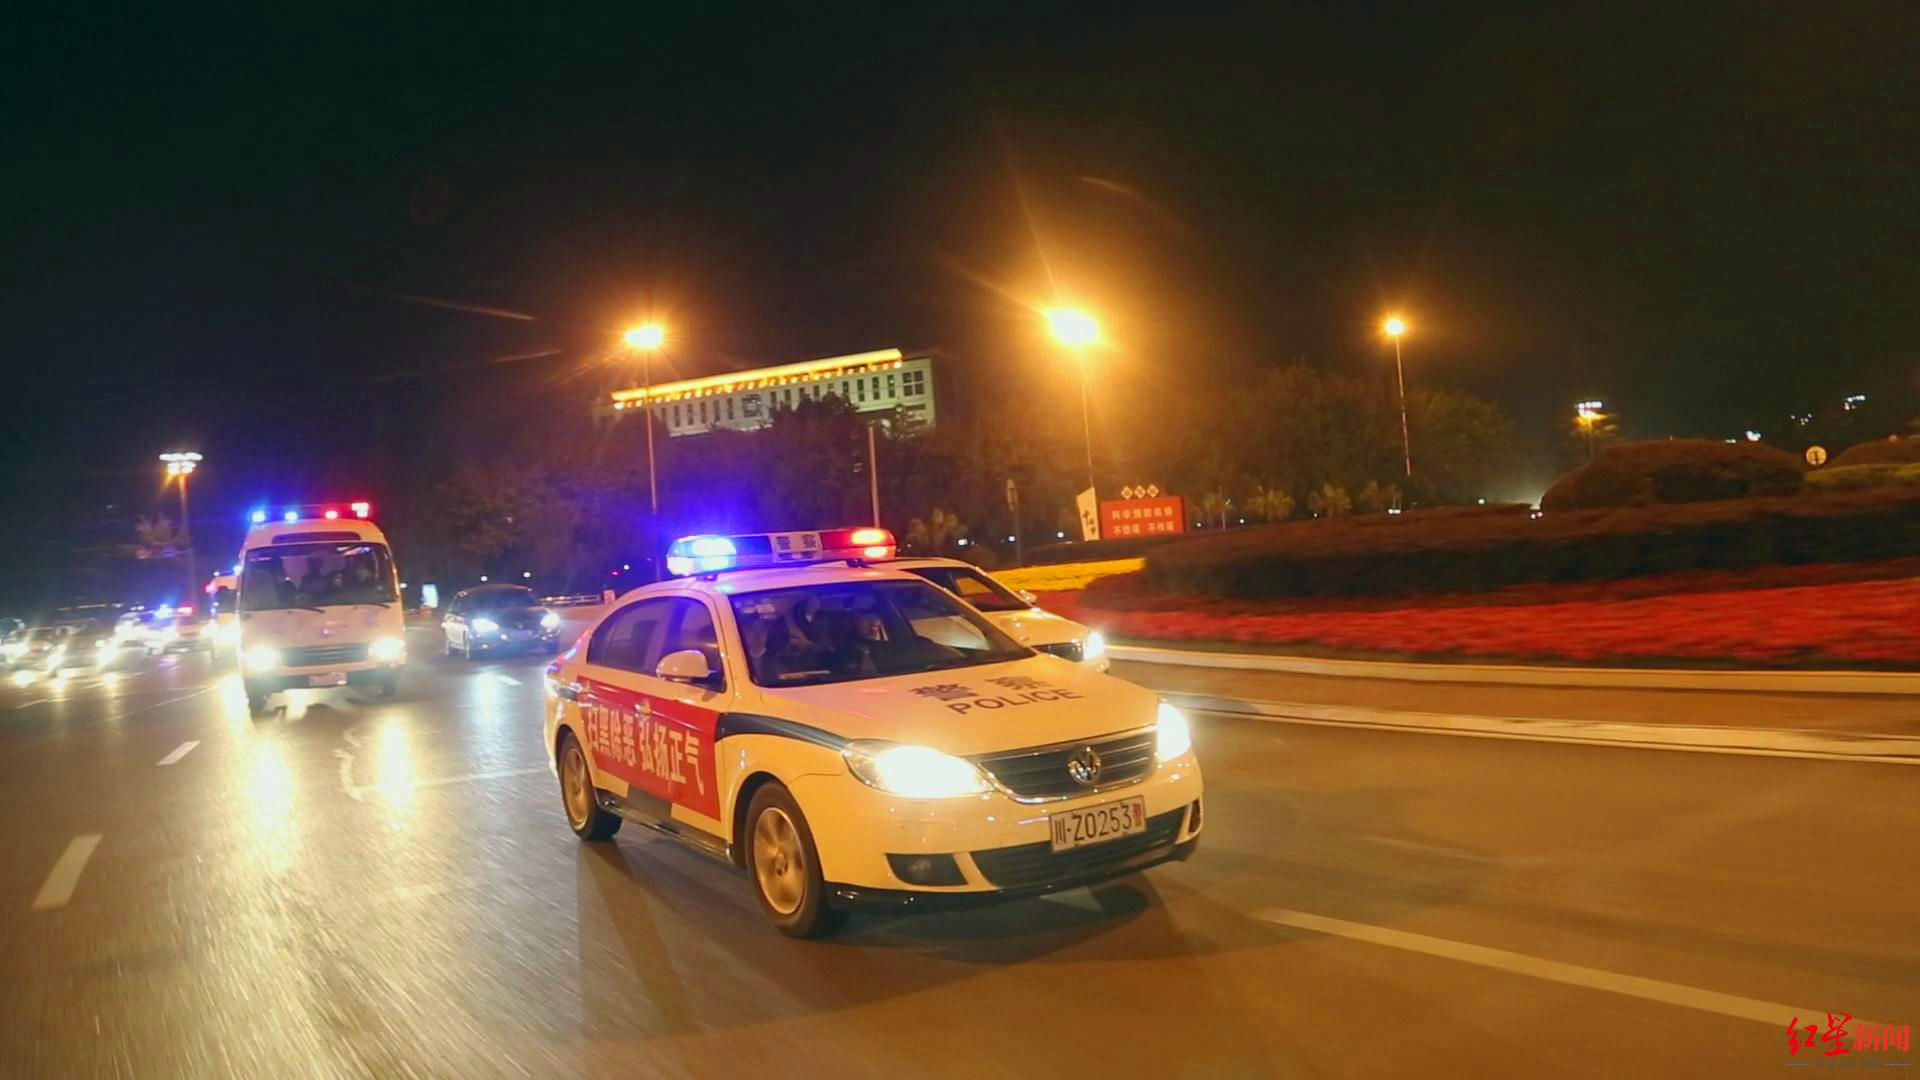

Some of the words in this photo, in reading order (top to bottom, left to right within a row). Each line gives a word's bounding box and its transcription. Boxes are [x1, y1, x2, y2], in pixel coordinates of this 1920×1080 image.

[947, 688, 1084, 715] POLICE
[638, 719, 705, 796] 弘扬正气
